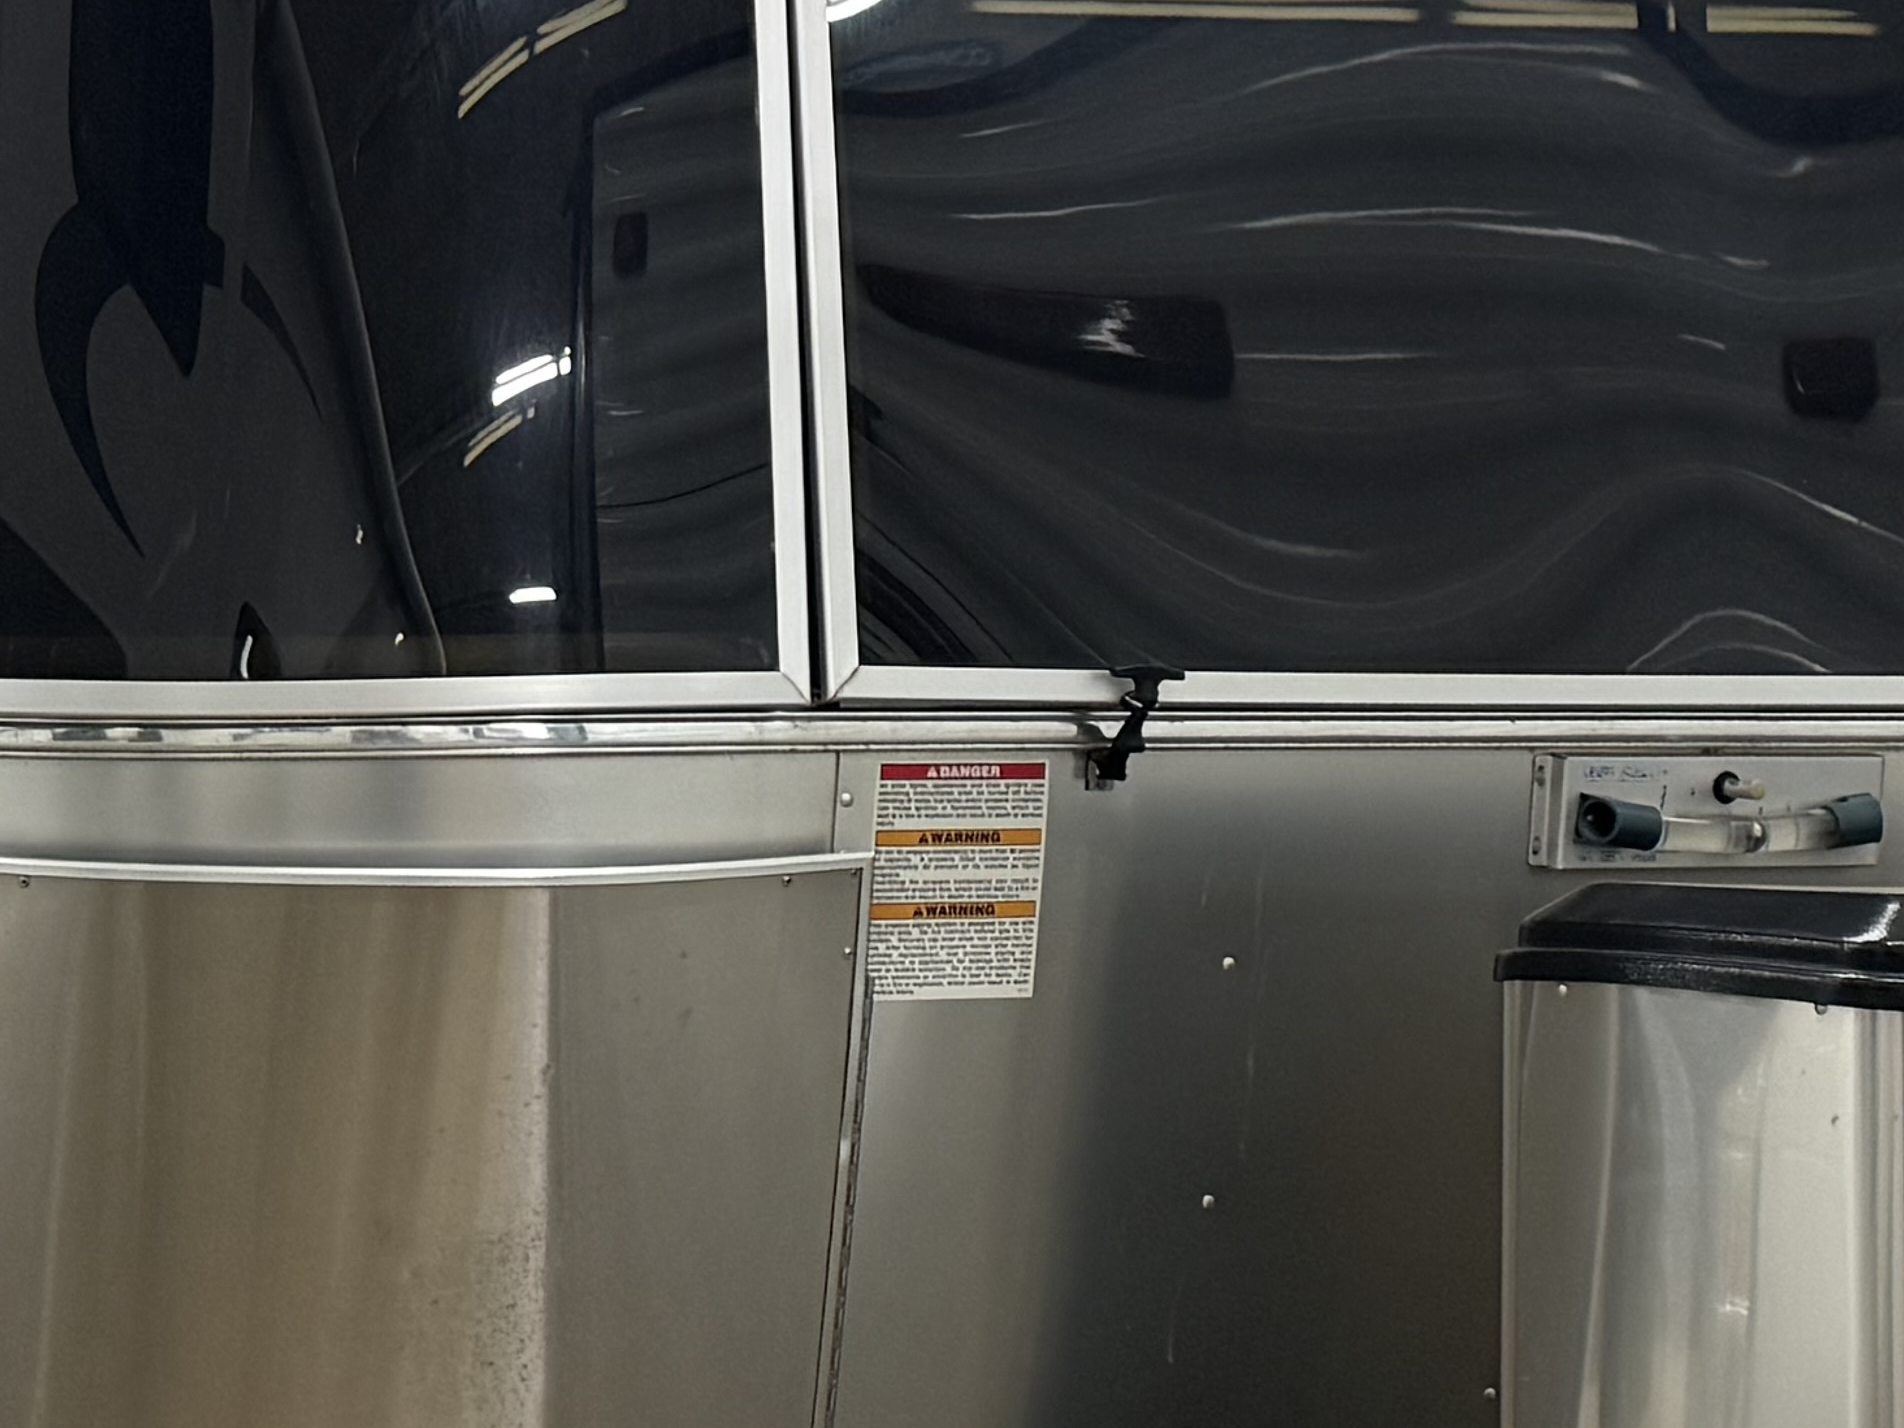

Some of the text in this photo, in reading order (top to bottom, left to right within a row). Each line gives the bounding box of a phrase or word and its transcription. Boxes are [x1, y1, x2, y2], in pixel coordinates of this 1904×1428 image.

[940, 765, 1001, 778] DANGER
[931, 831, 1001, 844] WARNING
[925, 904, 996, 918] WARNING
